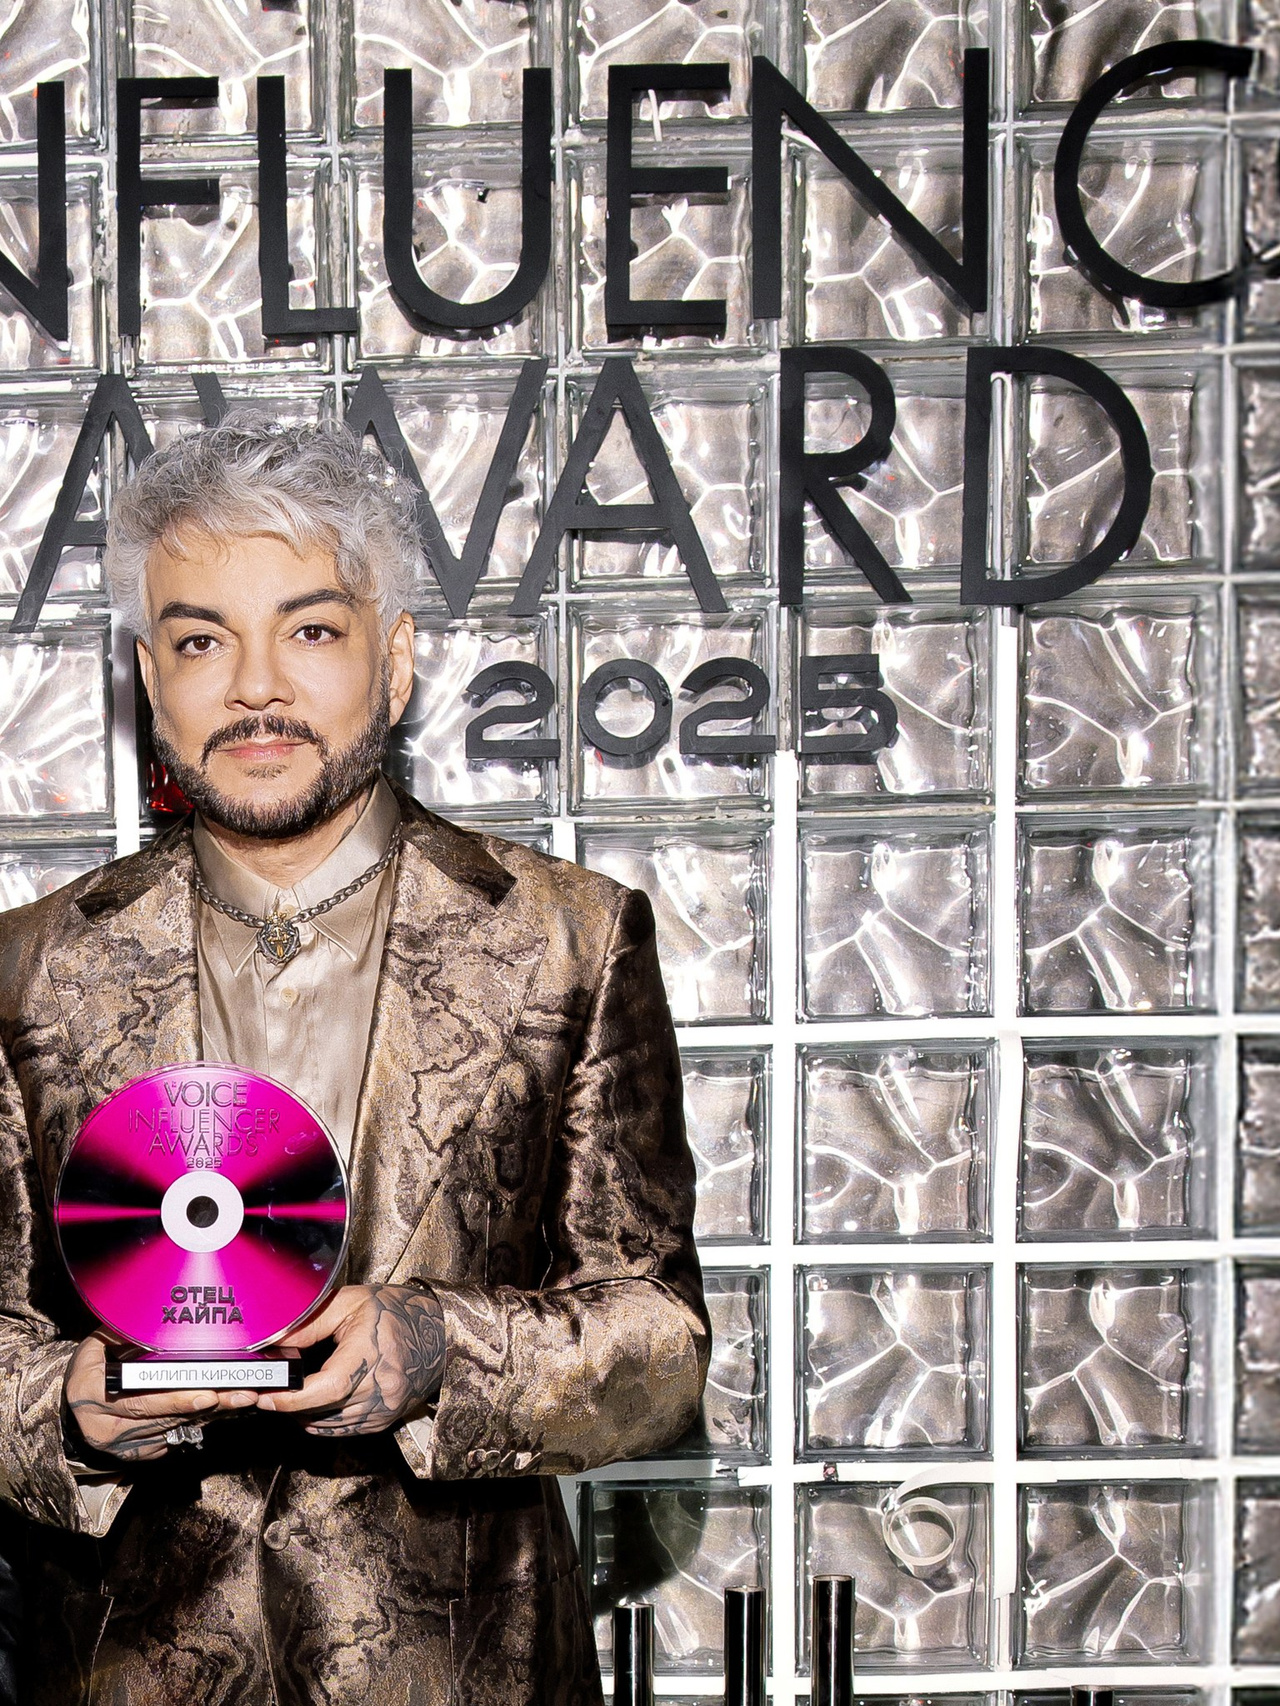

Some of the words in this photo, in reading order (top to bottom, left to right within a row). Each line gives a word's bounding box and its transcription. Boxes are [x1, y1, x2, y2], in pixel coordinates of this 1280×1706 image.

[465, 653, 898, 761] 2025
[163, 1080, 248, 1108] VOICE
[128, 1107, 281, 1134] INFLUENCER
[148, 1131, 259, 1157] AWARDS
[186, 1156, 223, 1169] 2025
[170, 1286, 236, 1307] ОТЕЦ
[161, 1302, 245, 1325] ХАЙПА
[138, 1369, 198, 1381] ФИЛИПП
[201, 1368, 274, 1381] КИРКОРОВ
